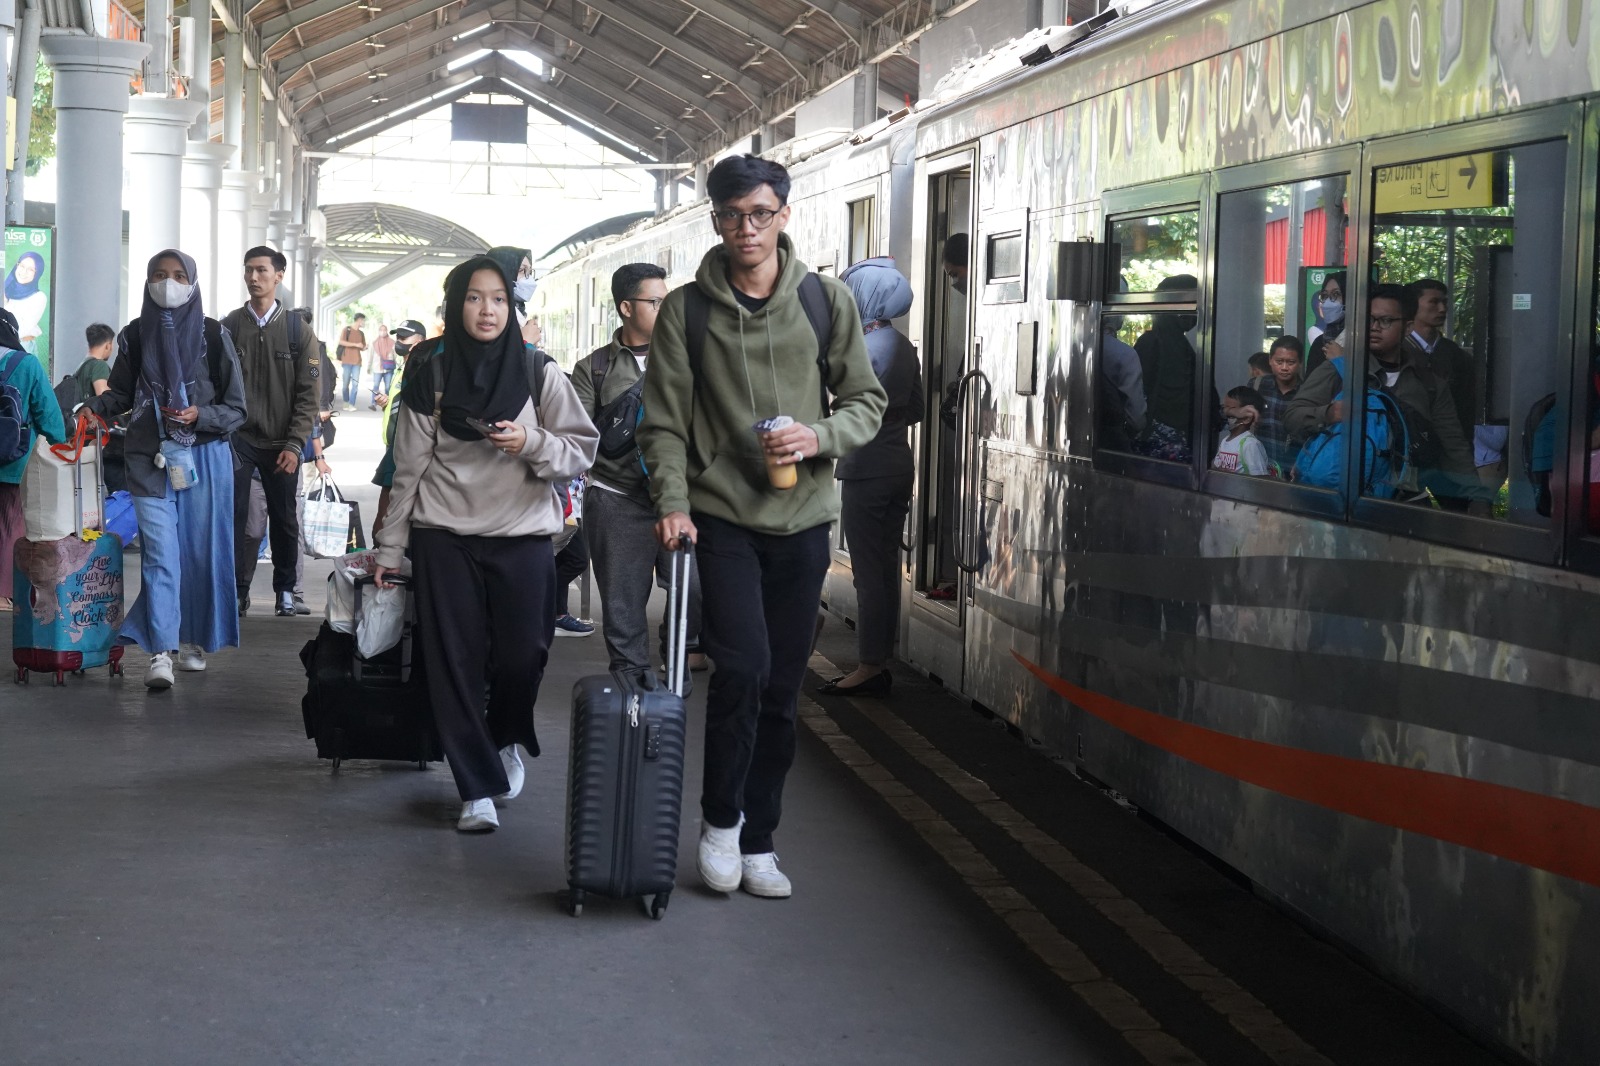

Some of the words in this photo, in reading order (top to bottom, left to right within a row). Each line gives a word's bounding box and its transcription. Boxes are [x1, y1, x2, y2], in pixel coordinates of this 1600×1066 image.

[87, 556, 112, 571] Live
[75, 571, 100, 587] your
[99, 569, 121, 590] Life
[72, 608, 104, 627] Clock
